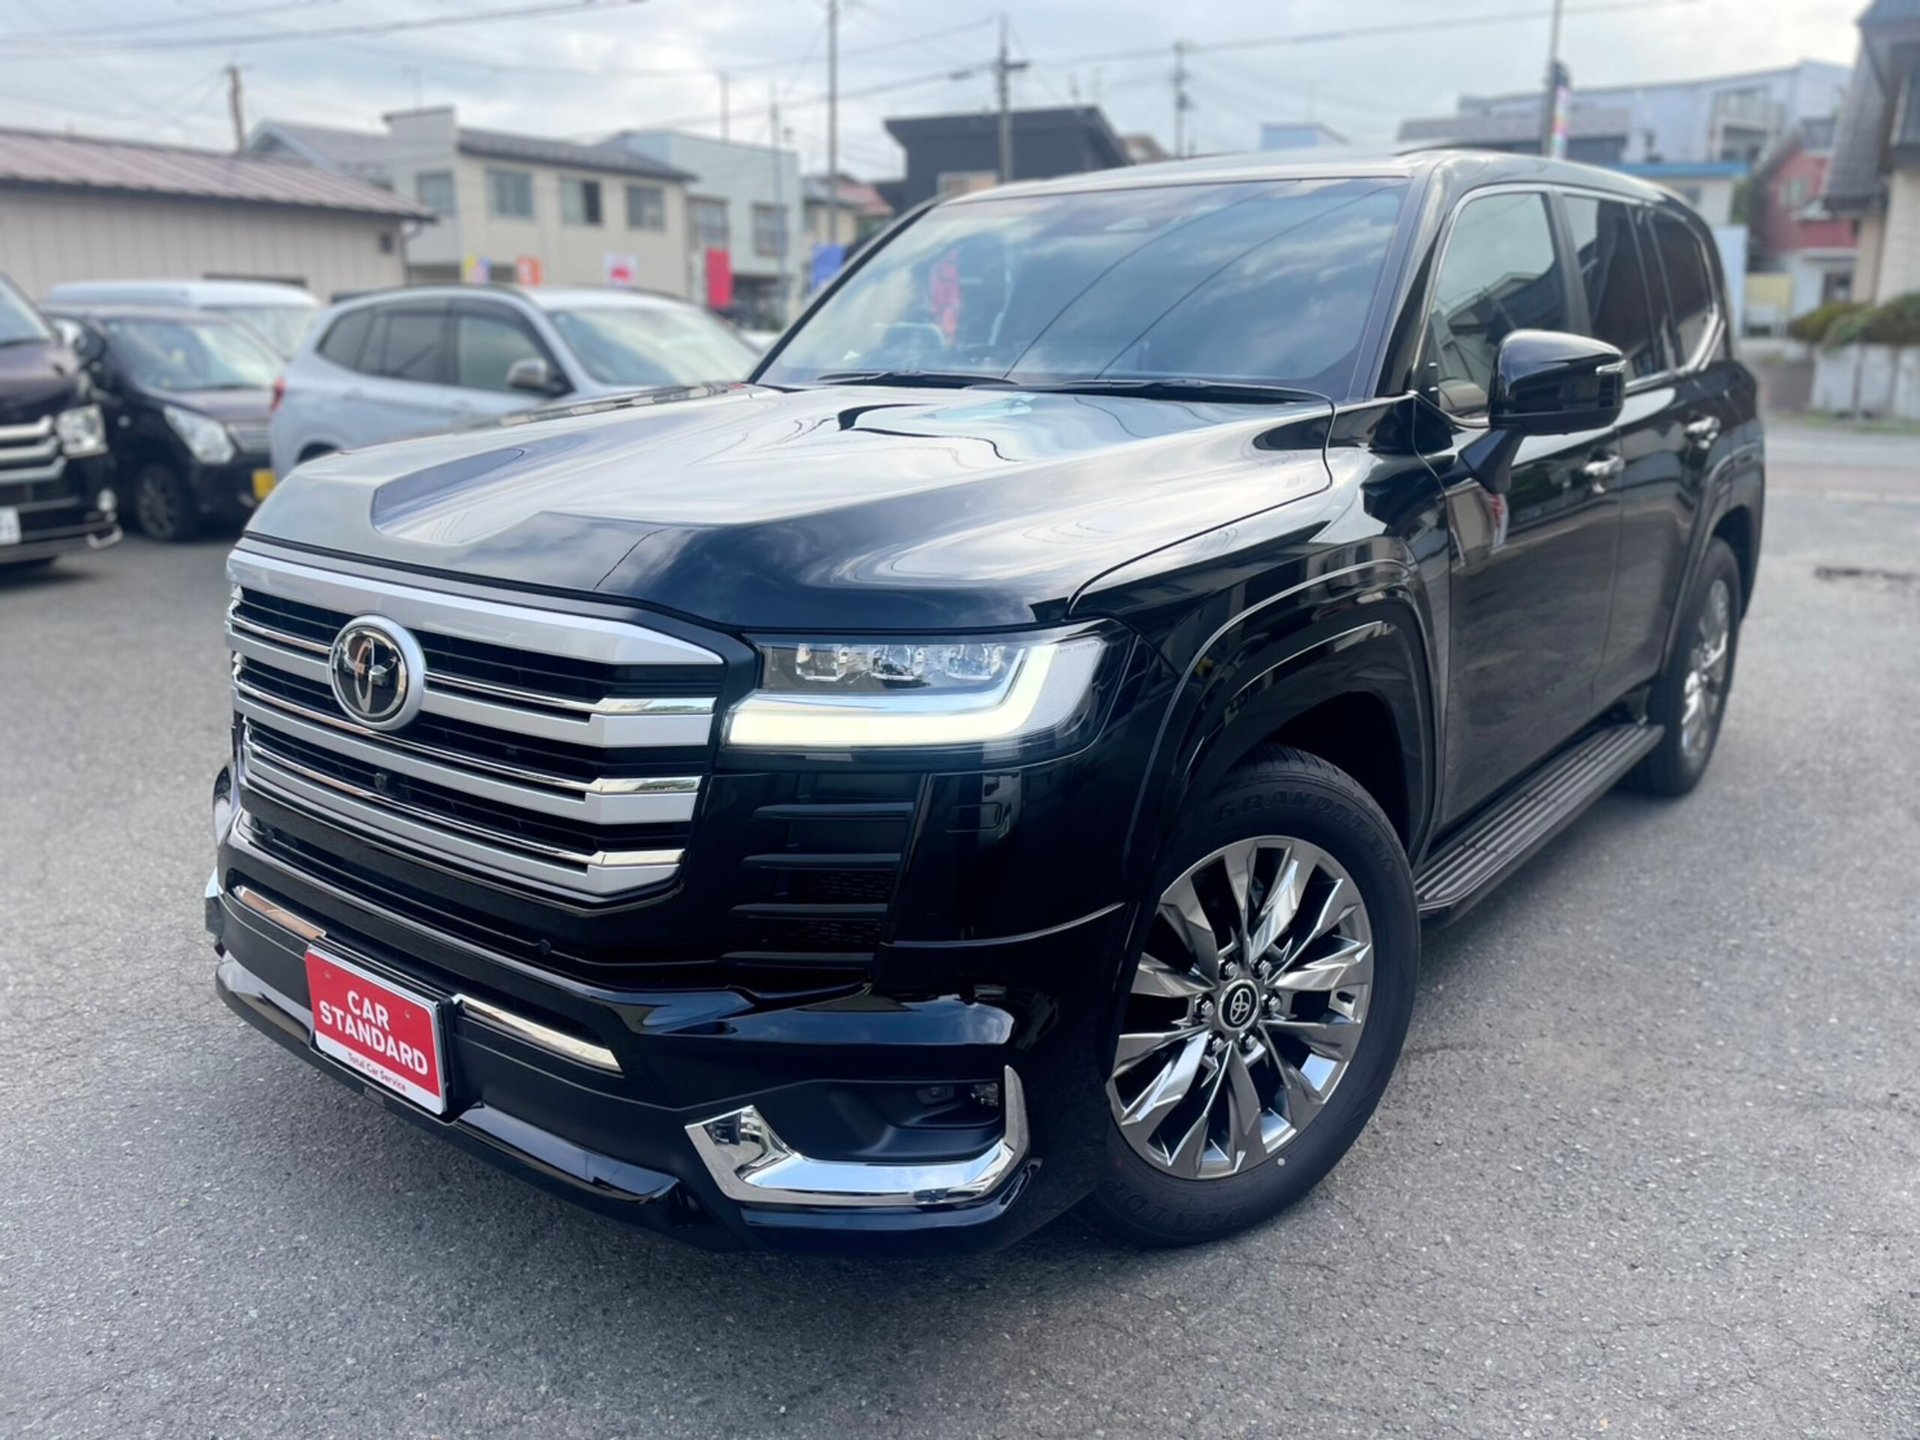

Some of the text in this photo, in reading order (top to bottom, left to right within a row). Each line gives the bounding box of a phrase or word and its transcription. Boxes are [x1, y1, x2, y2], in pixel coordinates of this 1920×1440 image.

[347, 990, 390, 1031] CAR
[319, 1000, 428, 1076] STANDARD
[366, 1062, 379, 1076] Car
[380, 1070, 407, 1093] Service
